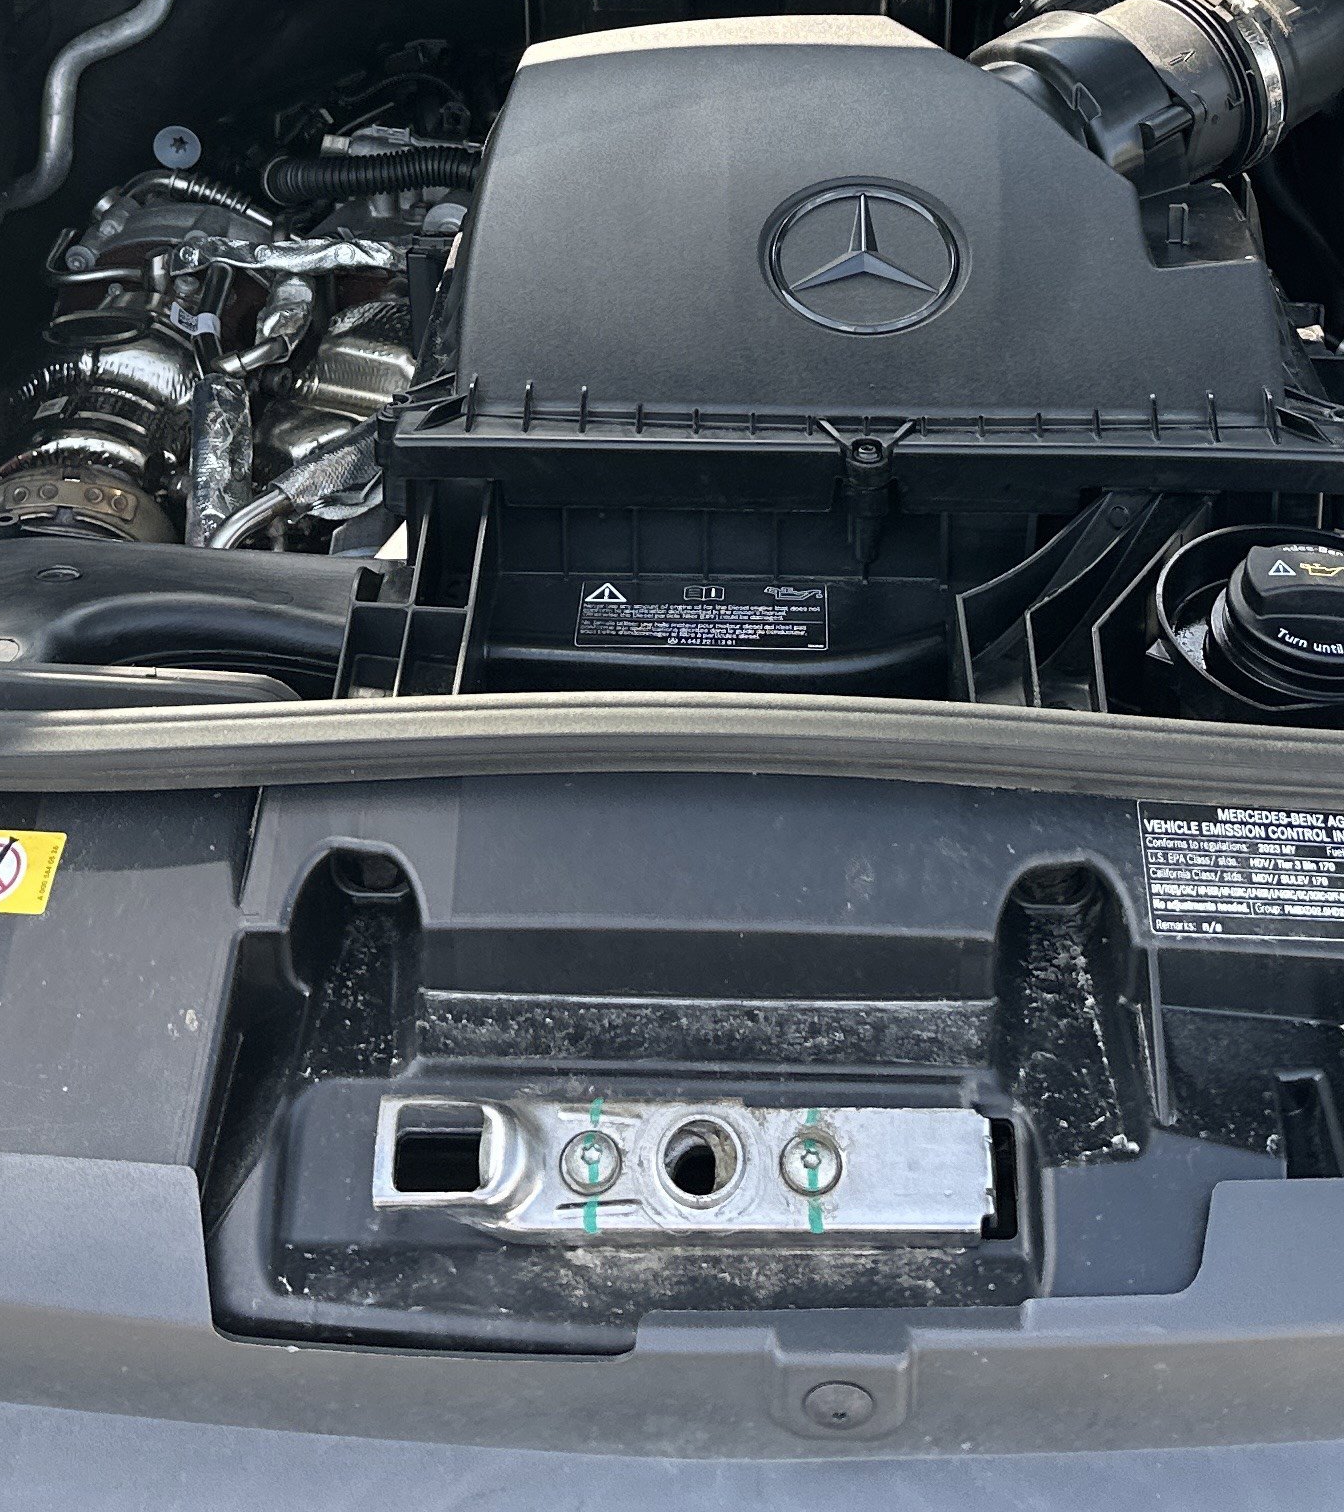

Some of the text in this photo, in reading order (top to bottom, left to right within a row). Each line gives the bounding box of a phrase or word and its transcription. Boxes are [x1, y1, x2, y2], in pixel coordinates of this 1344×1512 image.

[1277, 628, 1308, 648] Turn
[1313, 642, 1344, 654] until
[1217, 808, 1325, 828] MERCEDES-BENZ
[1144, 819, 1199, 835] VEHICLE
[1201, 821, 1266, 838] EMISSION
[1268, 825, 1331, 842] CONTROL
[1146, 836, 1188, 849] Conforms
[1189, 838, 1199, 849] to
[1257, 843, 1280, 854] 2023
[1168, 853, 1186, 864] EPA
[1150, 867, 1191, 879] California
[1201, 921, 1223, 934] n/a
